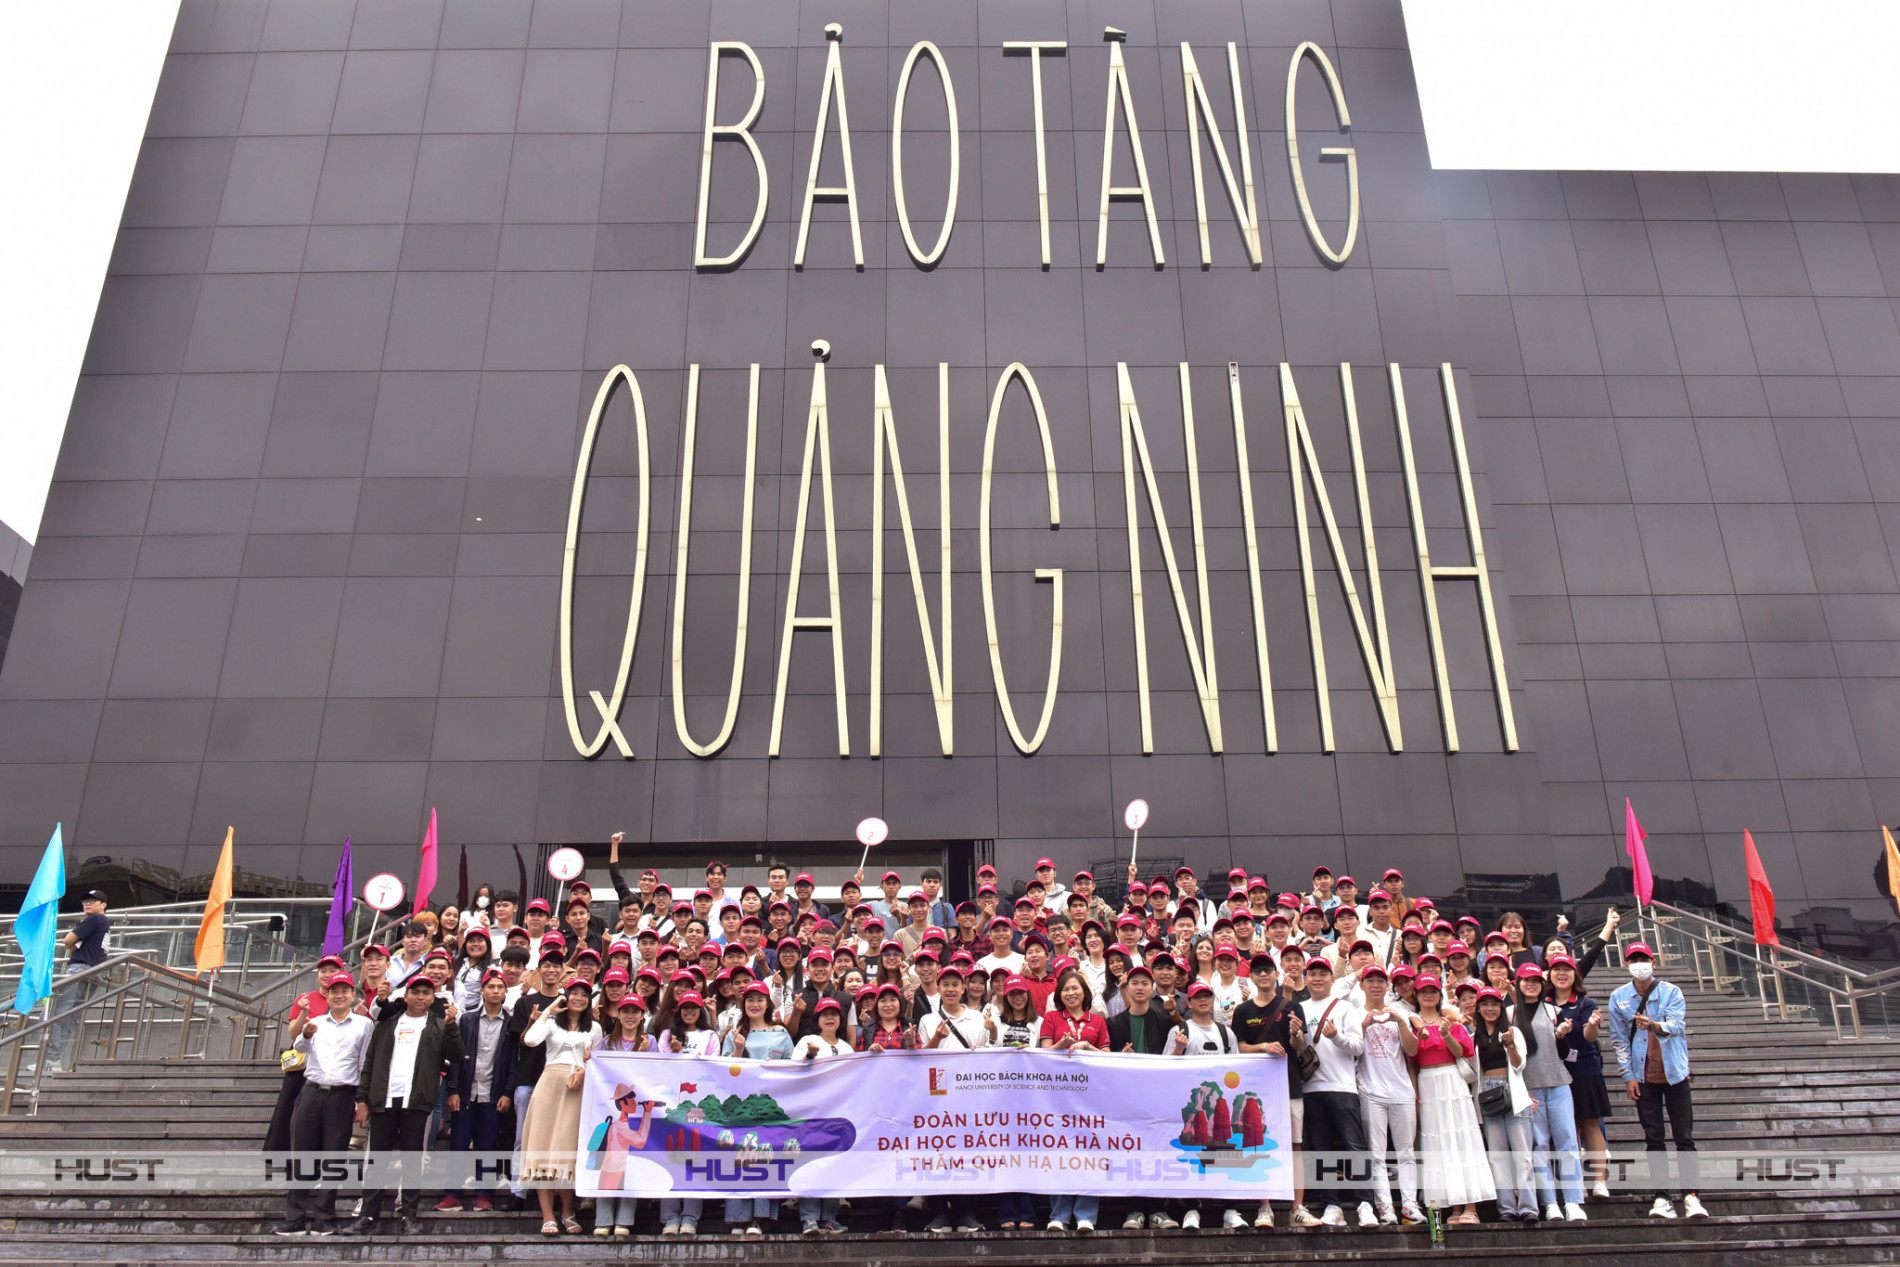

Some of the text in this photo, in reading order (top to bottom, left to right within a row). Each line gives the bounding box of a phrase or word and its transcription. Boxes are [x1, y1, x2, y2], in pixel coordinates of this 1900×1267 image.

[694, 22, 1360, 270] BẢO TÀNG
[559, 339, 1520, 758] QUẢNG NINH
[562, 864, 568, 876] 4
[380, 891, 386, 904] 1
[956, 1073, 971, 1083] ĐẠI
[975, 1073, 996, 1082] HỌC
[999, 1071, 1024, 1081] BÁCH
[1026, 1073, 1052, 1081] KHOA
[1055, 1072, 1069, 1082] HÀ
[913, 1111, 1105, 1130] ĐOÀN LƯU HỌC SINH
[878, 1130, 1142, 1153] ĐẠI HỌC BÁCH KHOA HÀ NỘI
[910, 1153, 1110, 1172] THĂM QUAN HẠ LONG
